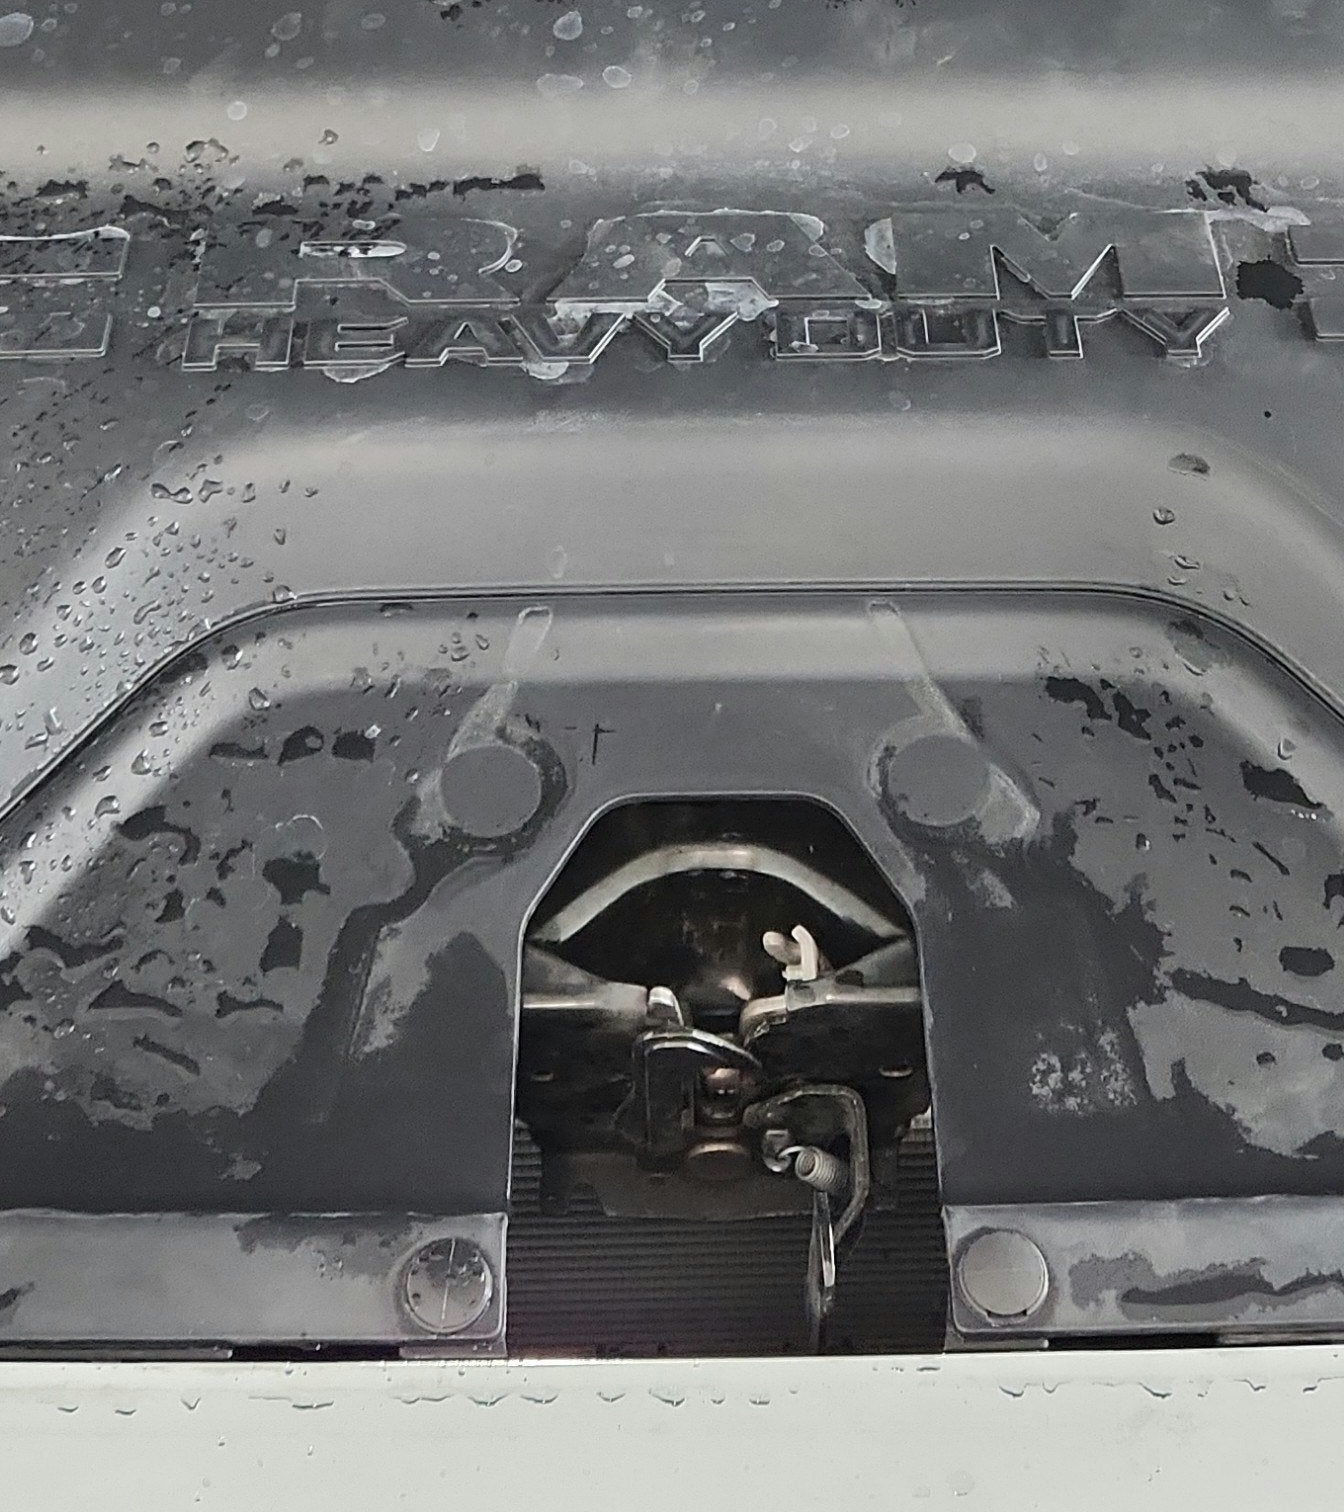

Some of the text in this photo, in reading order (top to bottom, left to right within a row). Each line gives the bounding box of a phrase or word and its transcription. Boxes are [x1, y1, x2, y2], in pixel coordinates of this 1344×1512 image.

[192, 210, 1226, 307] RAM
[181, 304, 1230, 371] HEAVY DUTY
